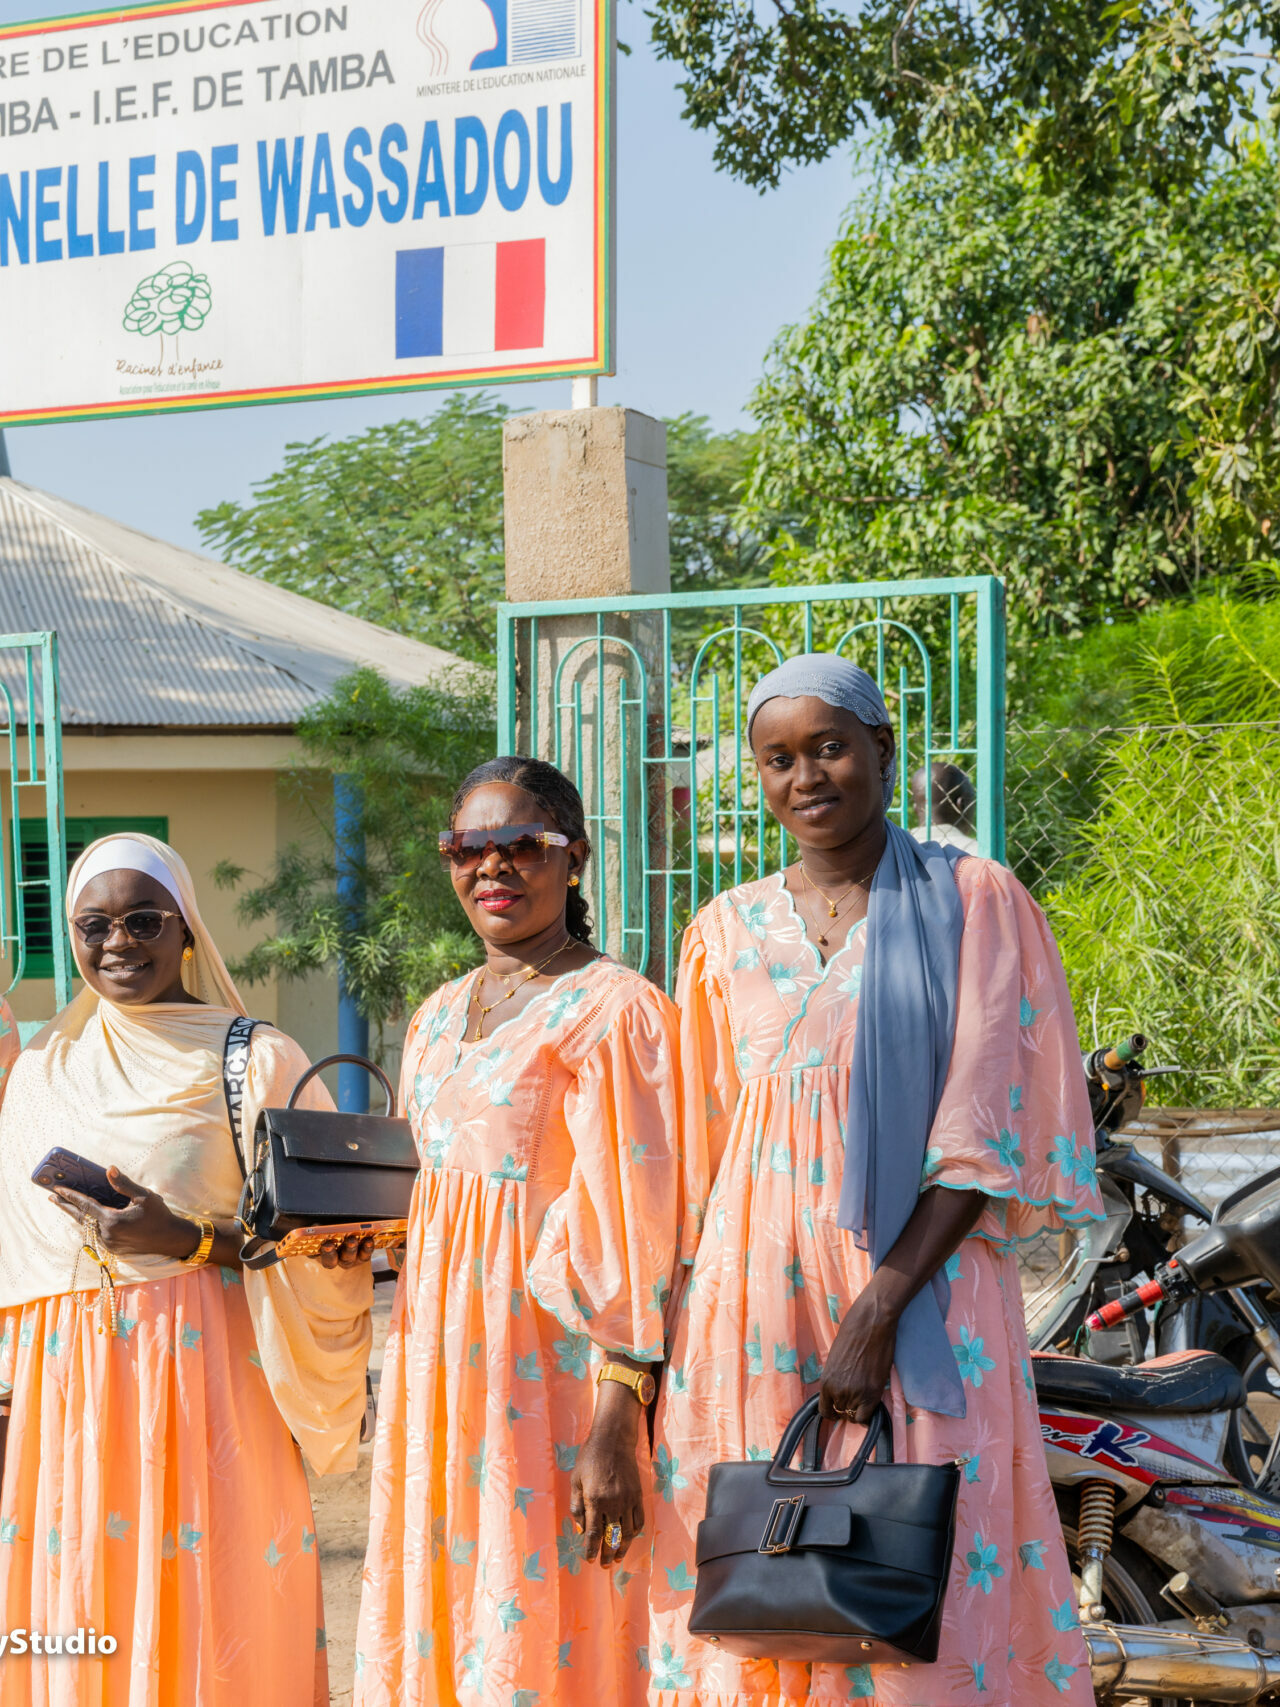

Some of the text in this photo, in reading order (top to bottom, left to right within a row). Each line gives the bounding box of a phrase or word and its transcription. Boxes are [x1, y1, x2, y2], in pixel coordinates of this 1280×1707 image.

[43, 43, 88, 72] DE
[102, 4, 348, 65] L'EDUCATION
[69, 111, 81, 119] -
[93, 80, 179, 125] I.E.F.
[193, 70, 243, 113] DE
[257, 49, 395, 102] TAMBA
[416, 64, 587, 97] MINISTERE DE L'EDUCATION NATIONALE
[176, 143, 239, 246] DE
[257, 101, 573, 236] WASSADOU
[116, 359, 162, 376] Racines
